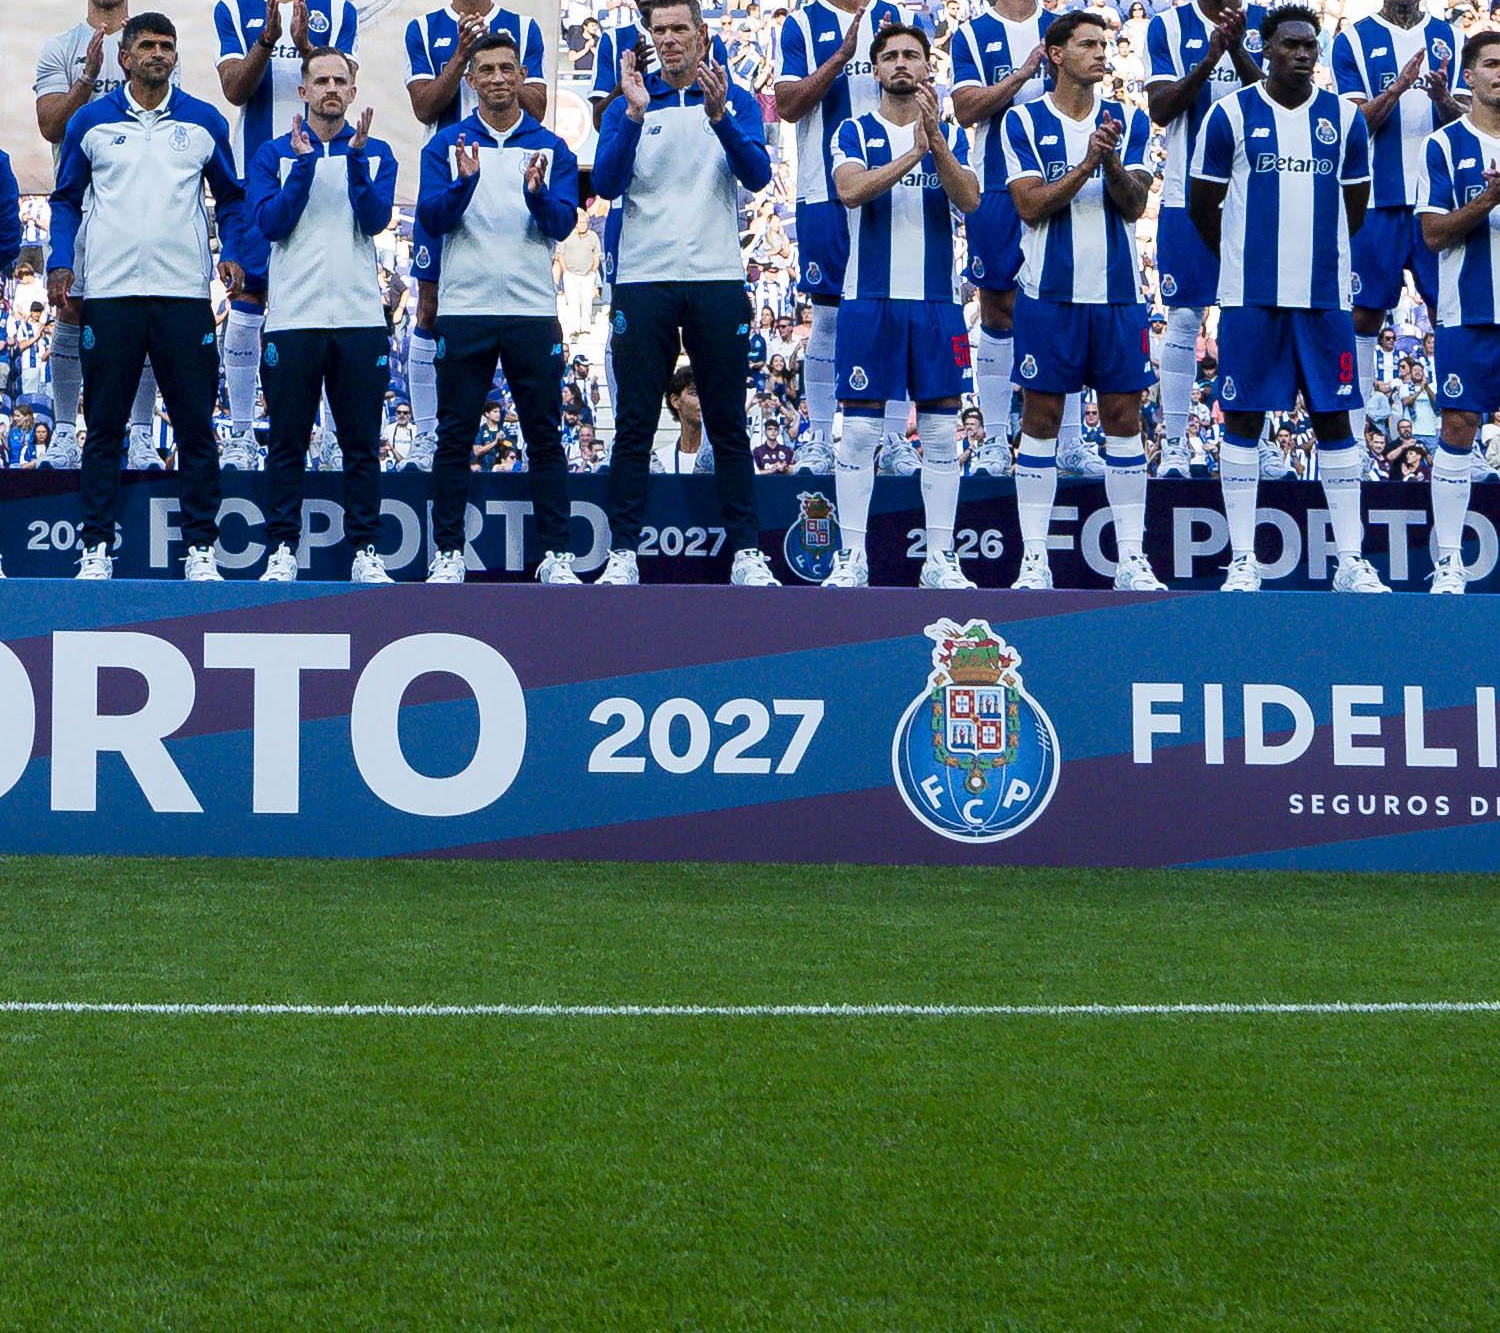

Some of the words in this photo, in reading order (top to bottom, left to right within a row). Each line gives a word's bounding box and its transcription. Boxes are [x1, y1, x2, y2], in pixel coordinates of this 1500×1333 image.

[1255, 152, 1334, 177] Betano
[637, 525, 728, 557] 2027
[906, 528, 1004, 559] 226
[588, 696, 826, 775] 2027
[1002, 779, 1032, 811] P
[1288, 793, 1451, 818] SEGUROS
